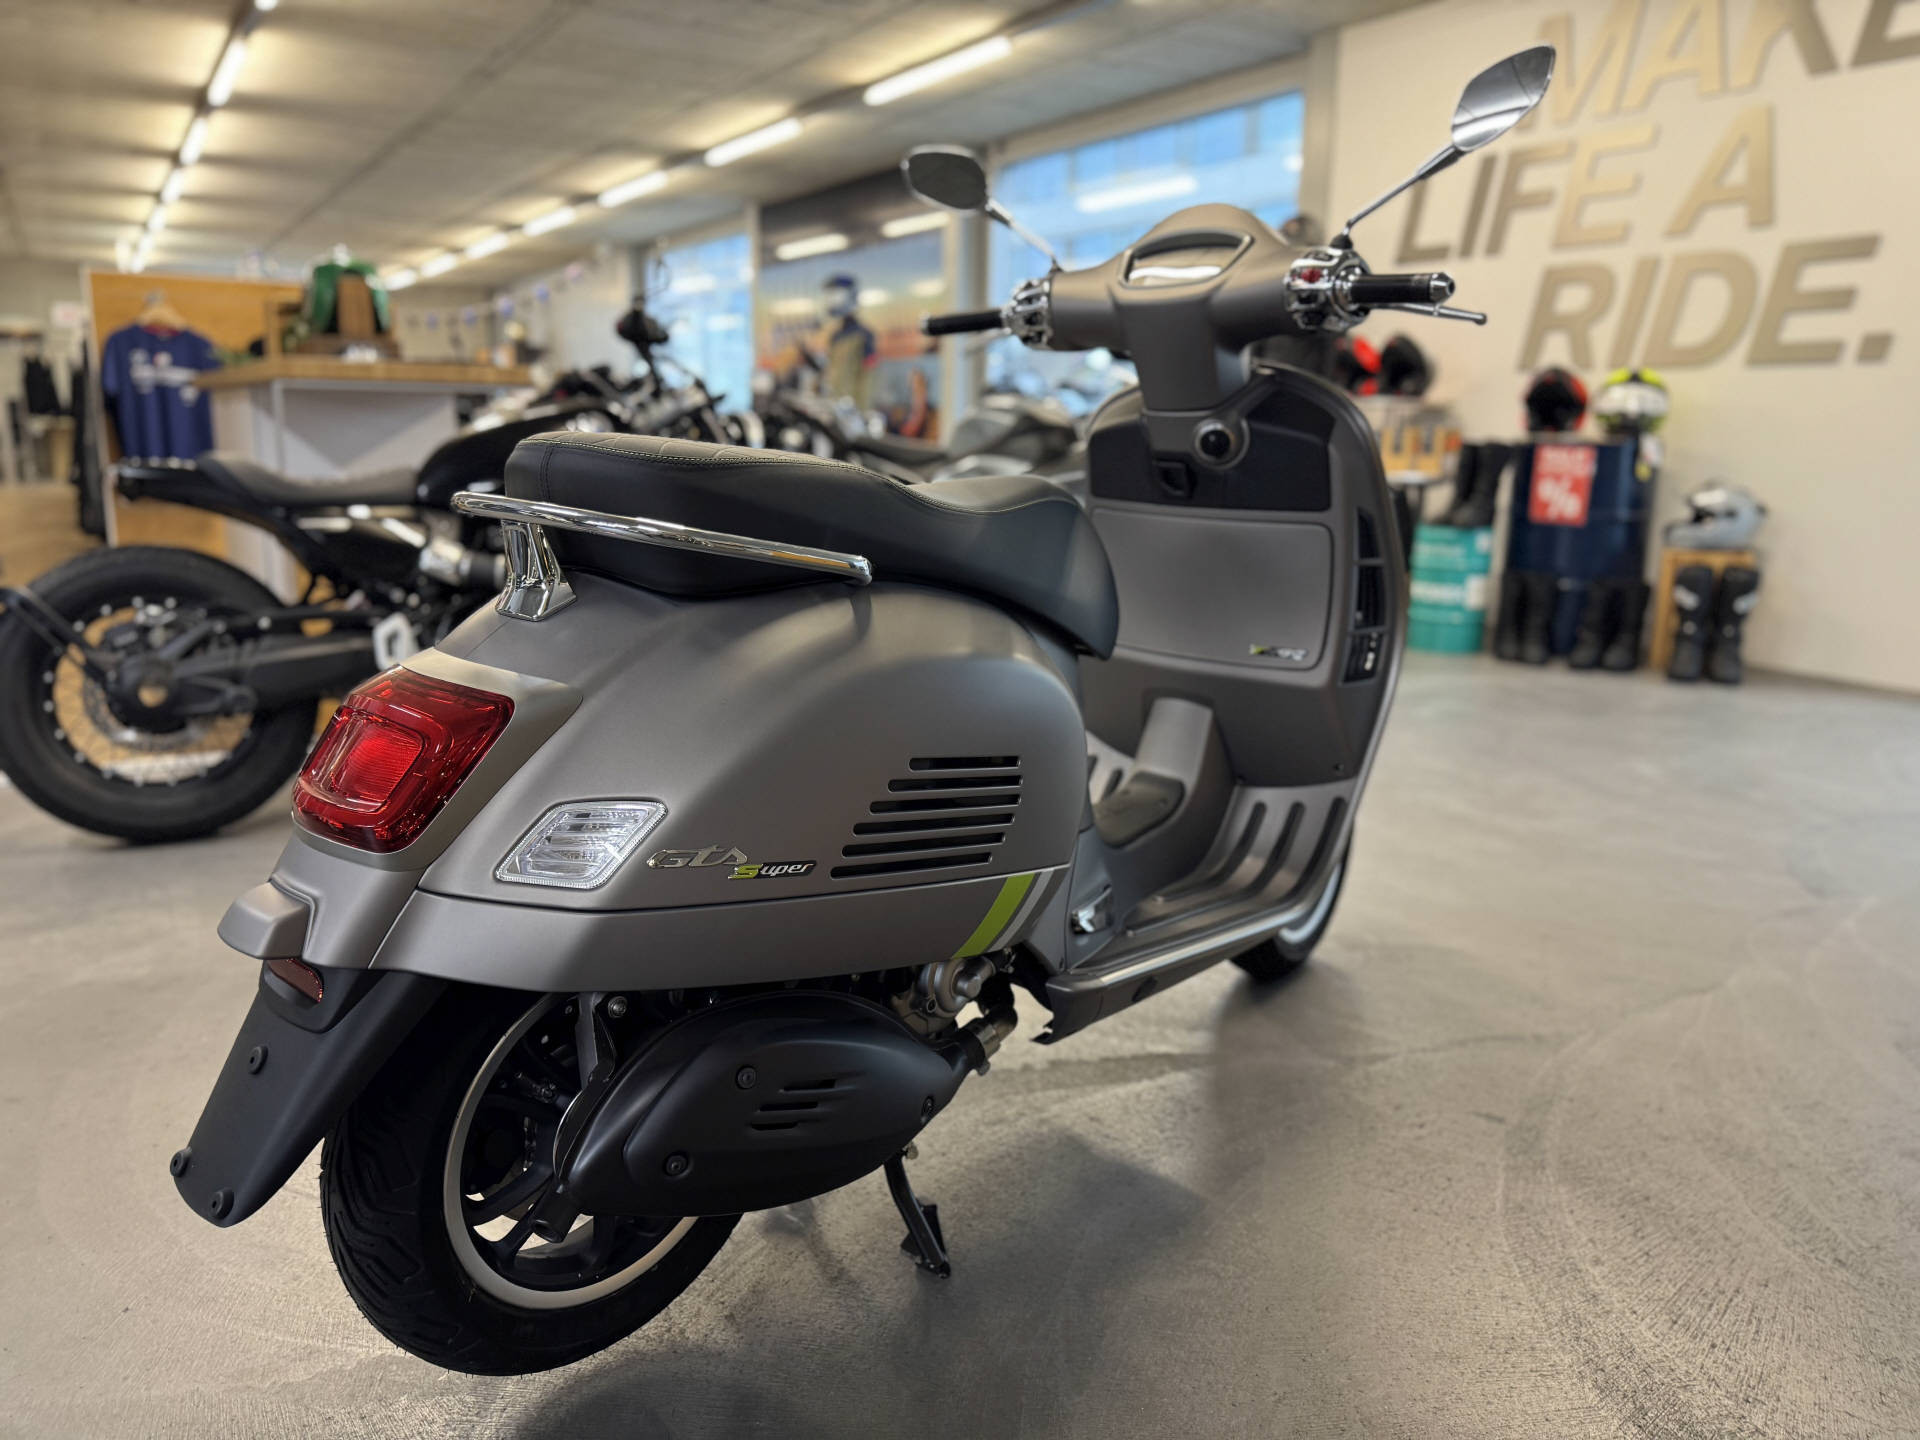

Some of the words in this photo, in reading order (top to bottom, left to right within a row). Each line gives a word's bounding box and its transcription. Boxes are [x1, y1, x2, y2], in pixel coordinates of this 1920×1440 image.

[1394, 122, 1658, 264] LIFE
[1662, 104, 1776, 239] A
[1516, 233, 1895, 371] RIDE.
[728, 862, 815, 880] Super
